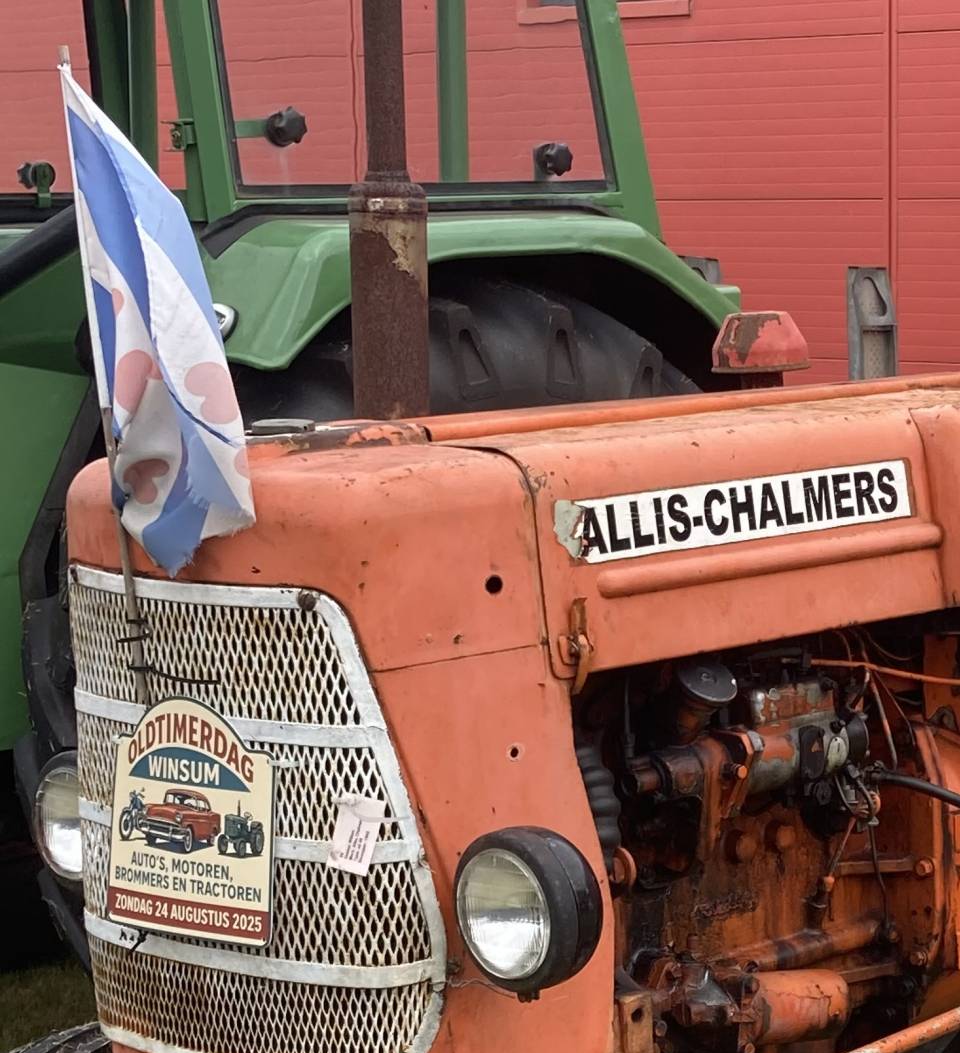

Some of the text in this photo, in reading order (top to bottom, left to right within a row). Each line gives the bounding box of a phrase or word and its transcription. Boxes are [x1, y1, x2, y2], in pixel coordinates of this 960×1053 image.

[582, 467, 899, 556] ALLIS-CHALMERS
[127, 712, 255, 784] OLDTIMERDAG
[148, 755, 221, 786] WINSUM
[115, 865, 262, 903] BROMMERS EN TRACTOREN
[130, 850, 234, 882] AUTO'S, MOTOREN,
[115, 893, 262, 933] ZONDAG 24 AUGUSTUS 2025
